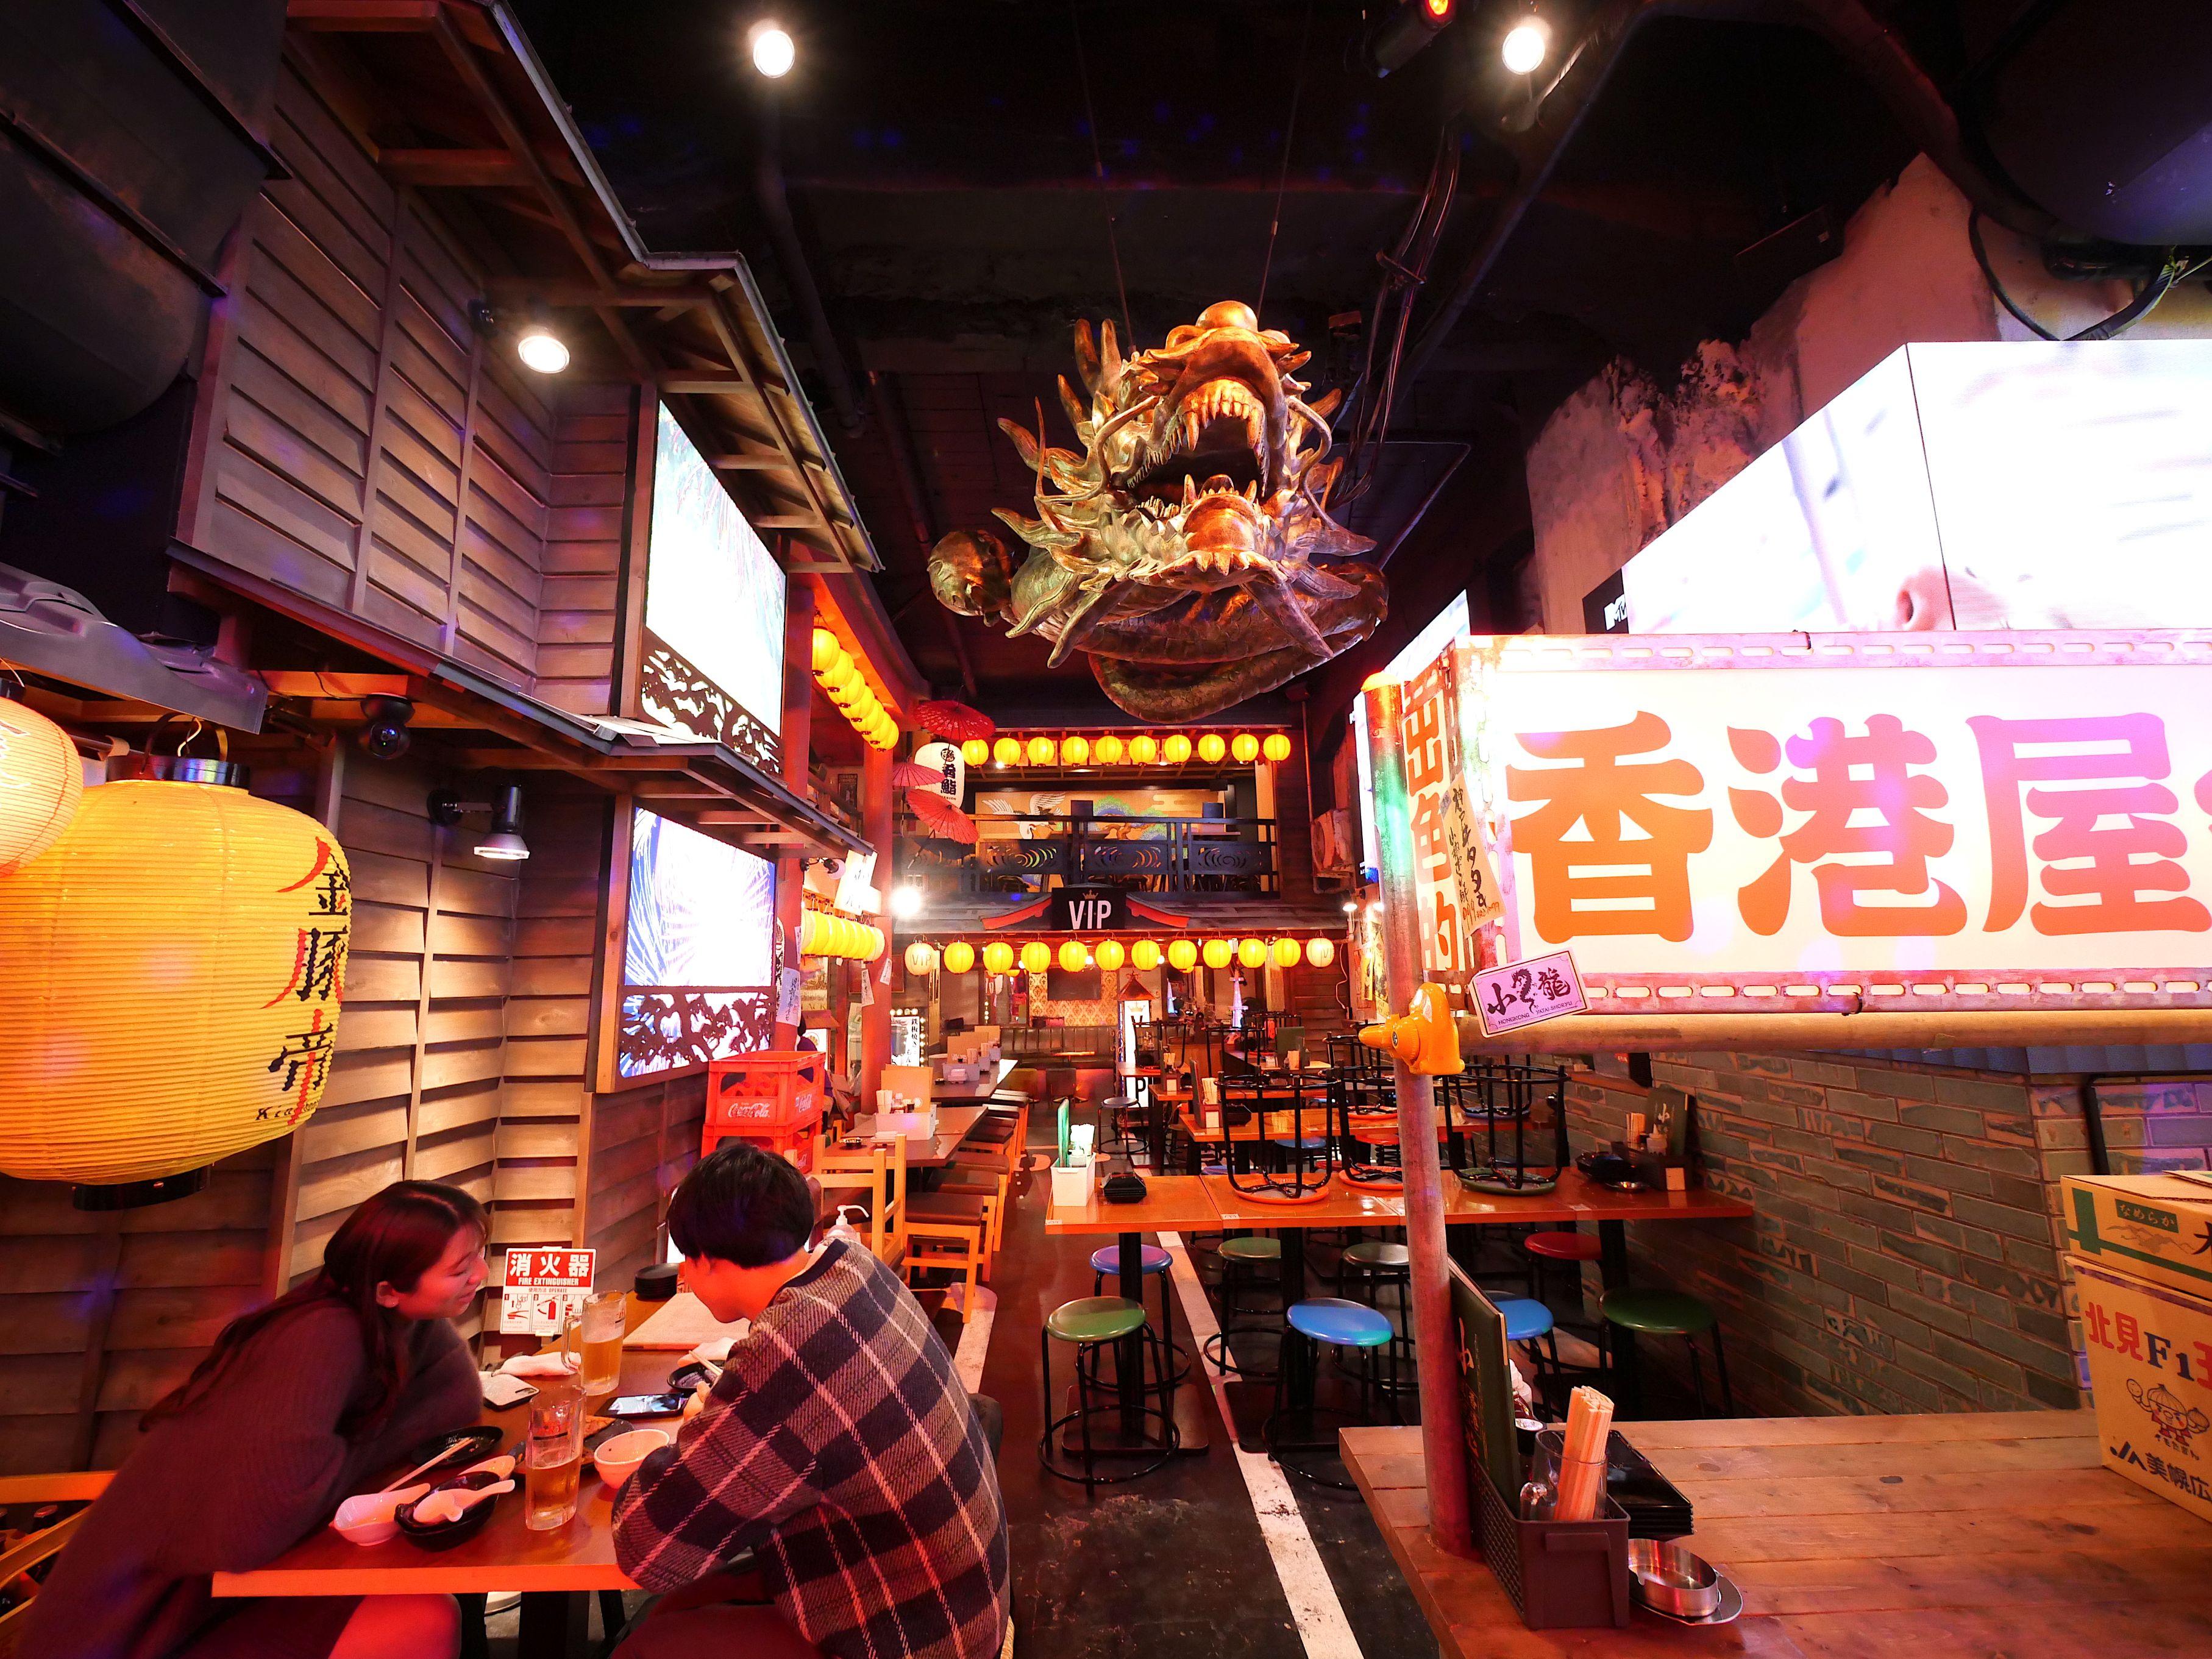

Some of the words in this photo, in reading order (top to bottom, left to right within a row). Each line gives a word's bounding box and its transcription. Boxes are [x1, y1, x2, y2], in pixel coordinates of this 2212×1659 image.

[1405, 696, 1457, 971] 出色的
[1507, 711, 2212, 943] 香港屋
[1069, 900, 1111, 929] VIP
[912, 954, 931, 966] VIP
[1487, 967, 1571, 1015] 小龍
[1498, 1012, 1530, 1025] HONGKONG
[1535, 1001, 1573, 1015] YATAI-SHORYU
[2120, 1204, 2175, 1227] なめらか
[510, 1253, 589, 1277] 消火器
[518, 1277, 532, 1285] FIRE
[534, 1277, 579, 1286] EXTINGUISHER
